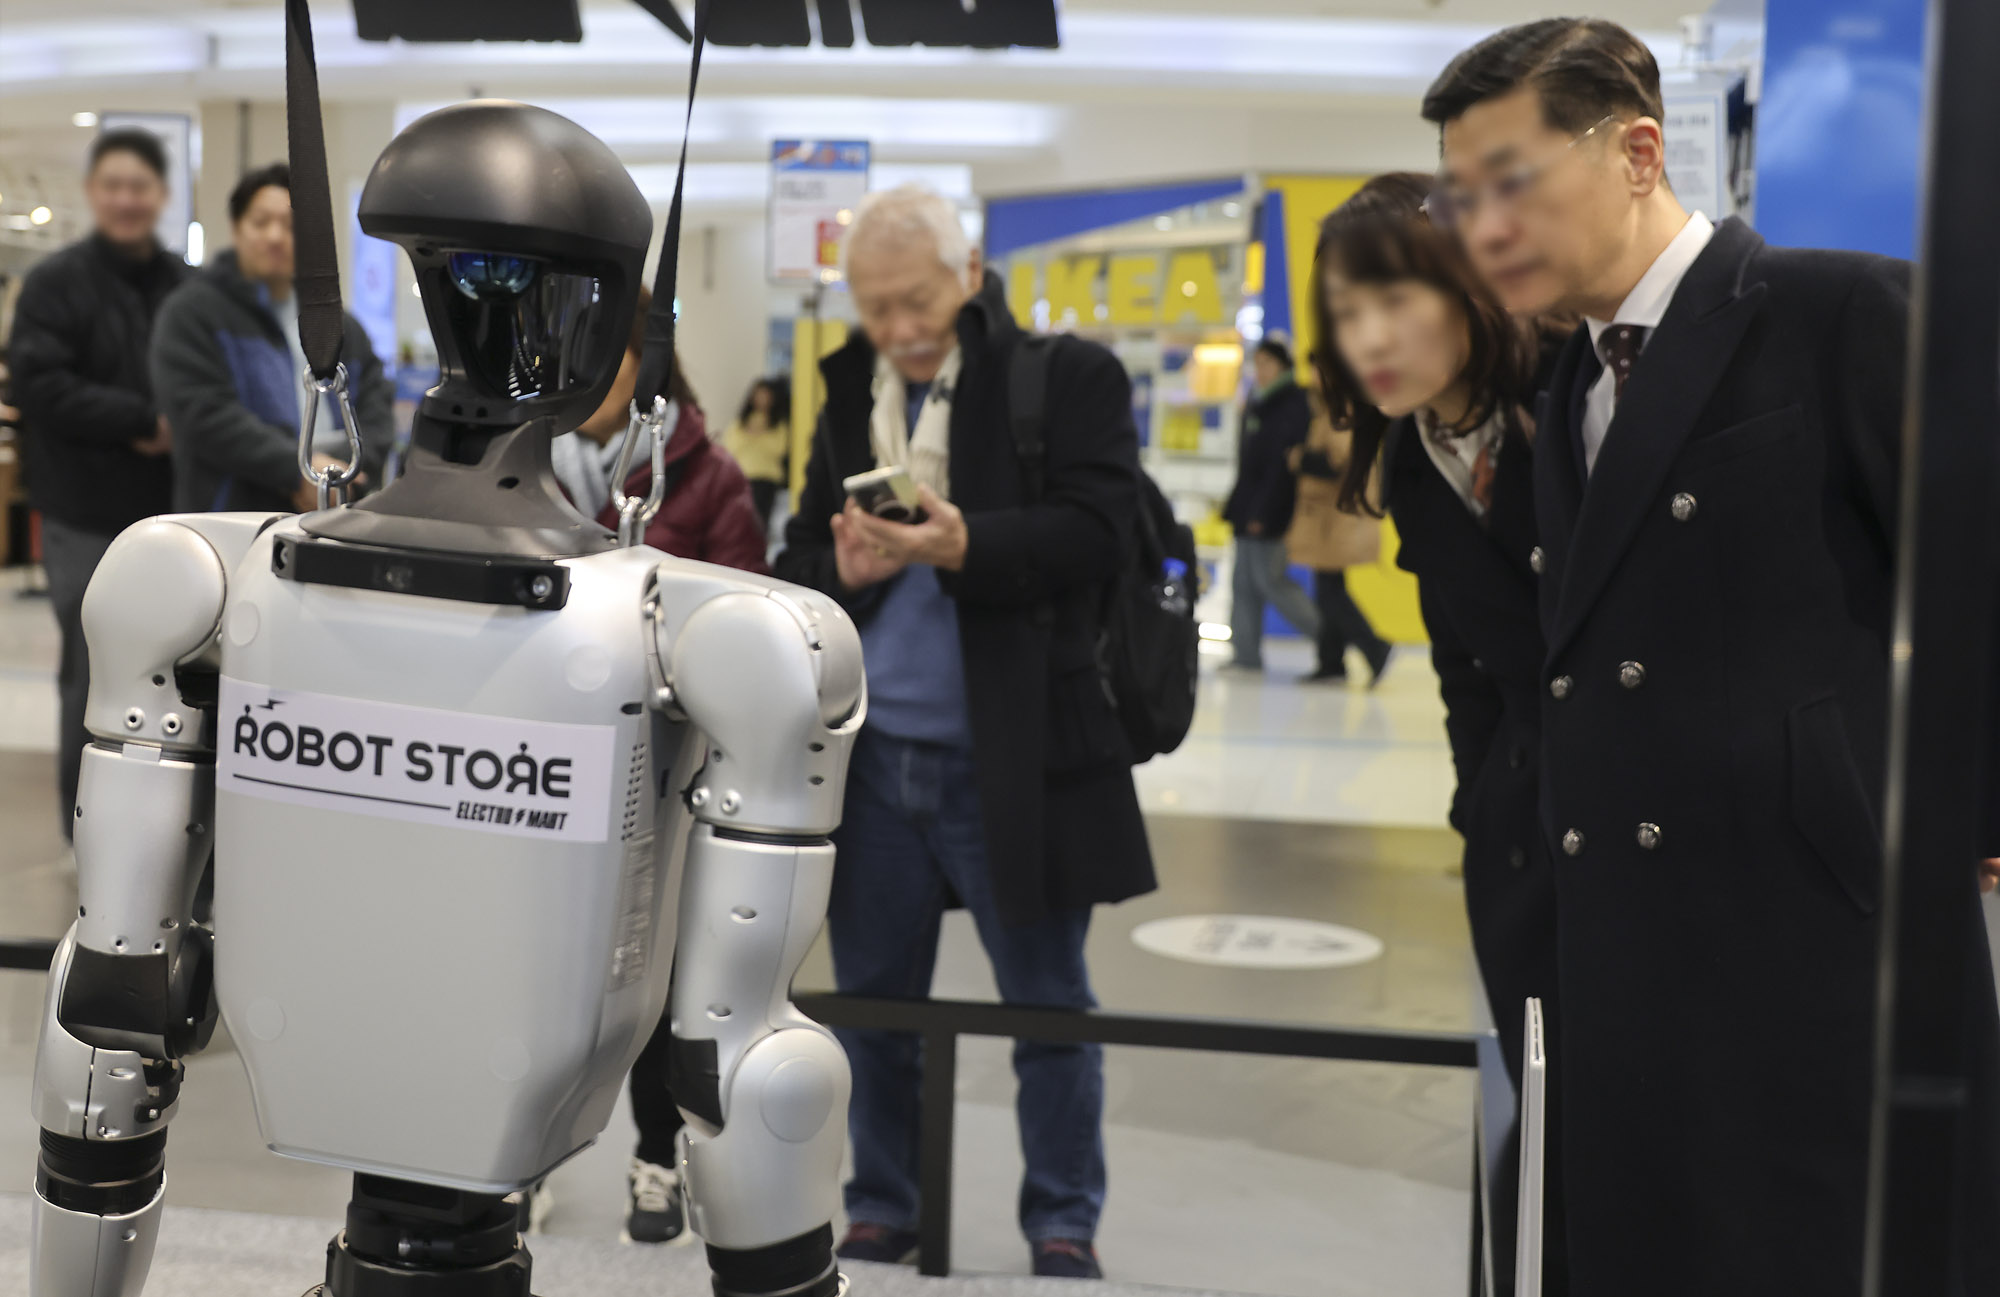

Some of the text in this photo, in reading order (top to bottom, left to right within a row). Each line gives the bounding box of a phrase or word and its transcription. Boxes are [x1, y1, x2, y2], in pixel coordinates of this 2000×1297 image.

[1009, 252, 1223, 331] IKEA
[234, 705, 572, 798] ROBOT STORE
[526, 810, 568, 831] MART
